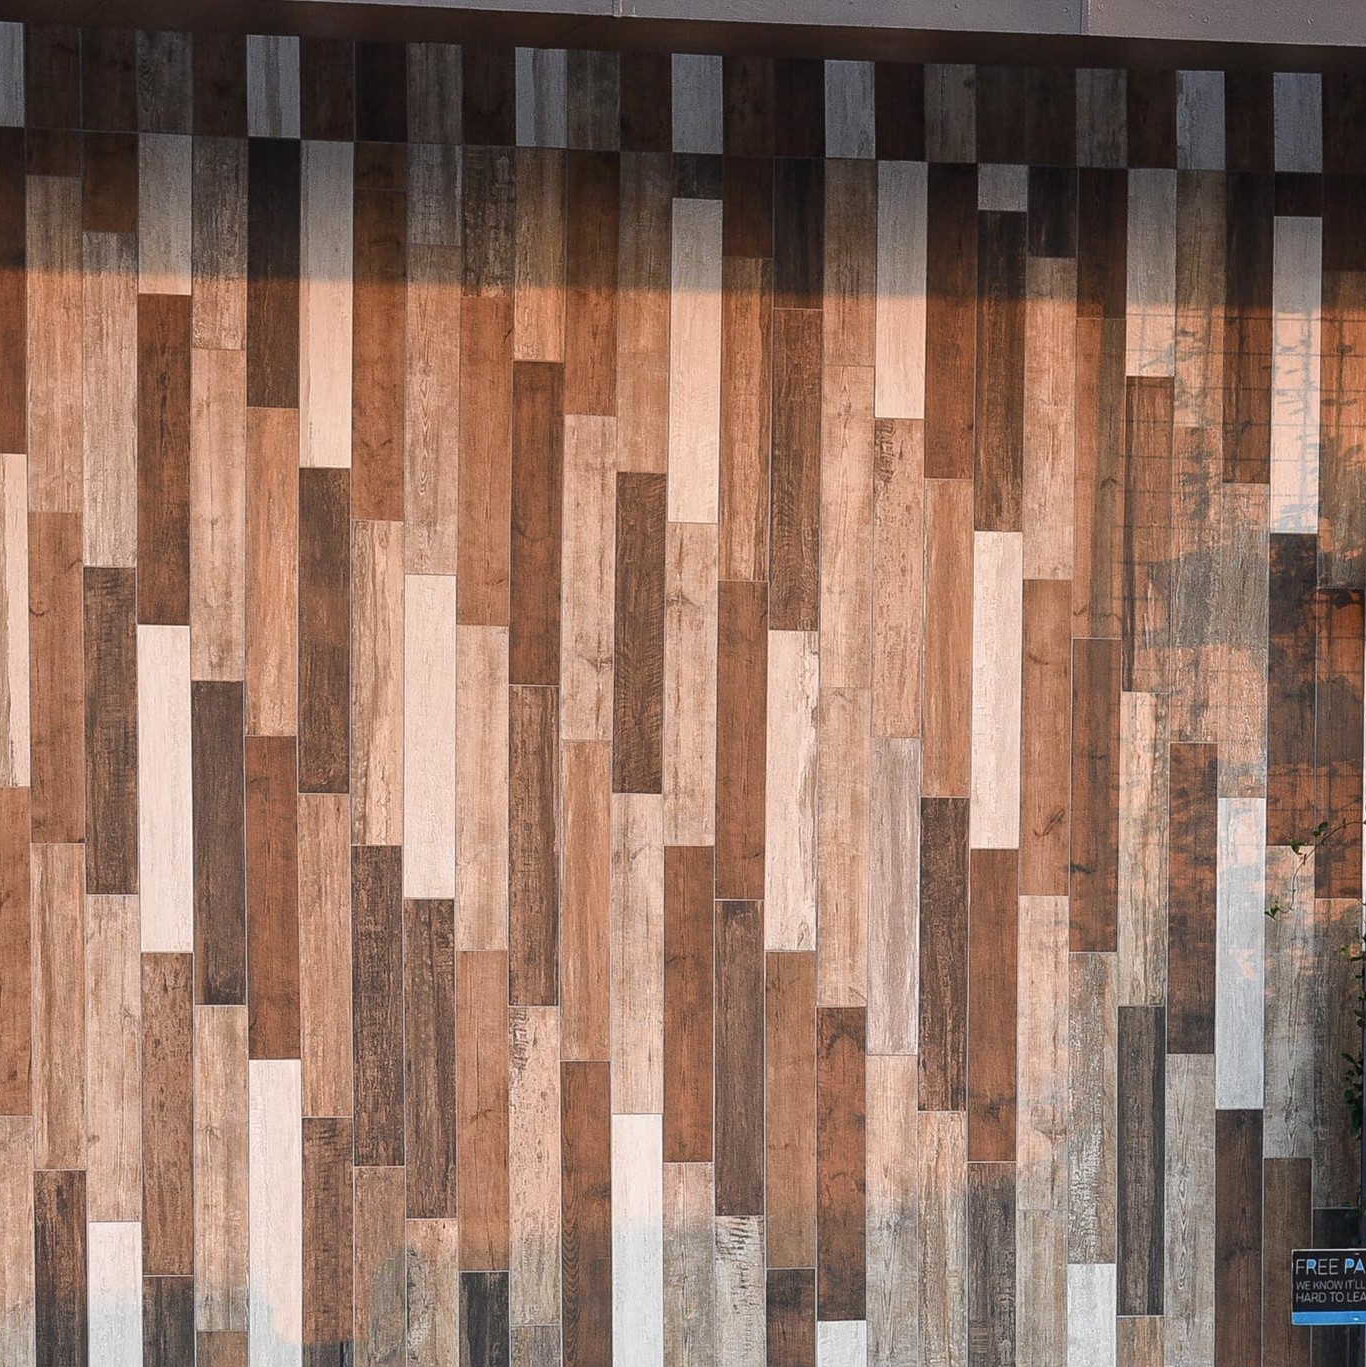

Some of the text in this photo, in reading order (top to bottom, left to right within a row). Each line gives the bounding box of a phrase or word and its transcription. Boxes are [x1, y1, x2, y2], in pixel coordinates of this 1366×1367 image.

[1295, 1258, 1339, 1275] FREE
[1296, 1281, 1311, 1290] WE
[1313, 1280, 1343, 1290] KNOW
[1344, 1279, 1366, 1290] IT'LL
[1296, 1292, 1326, 1303] HARD
[1330, 1291, 1344, 1303] TO
